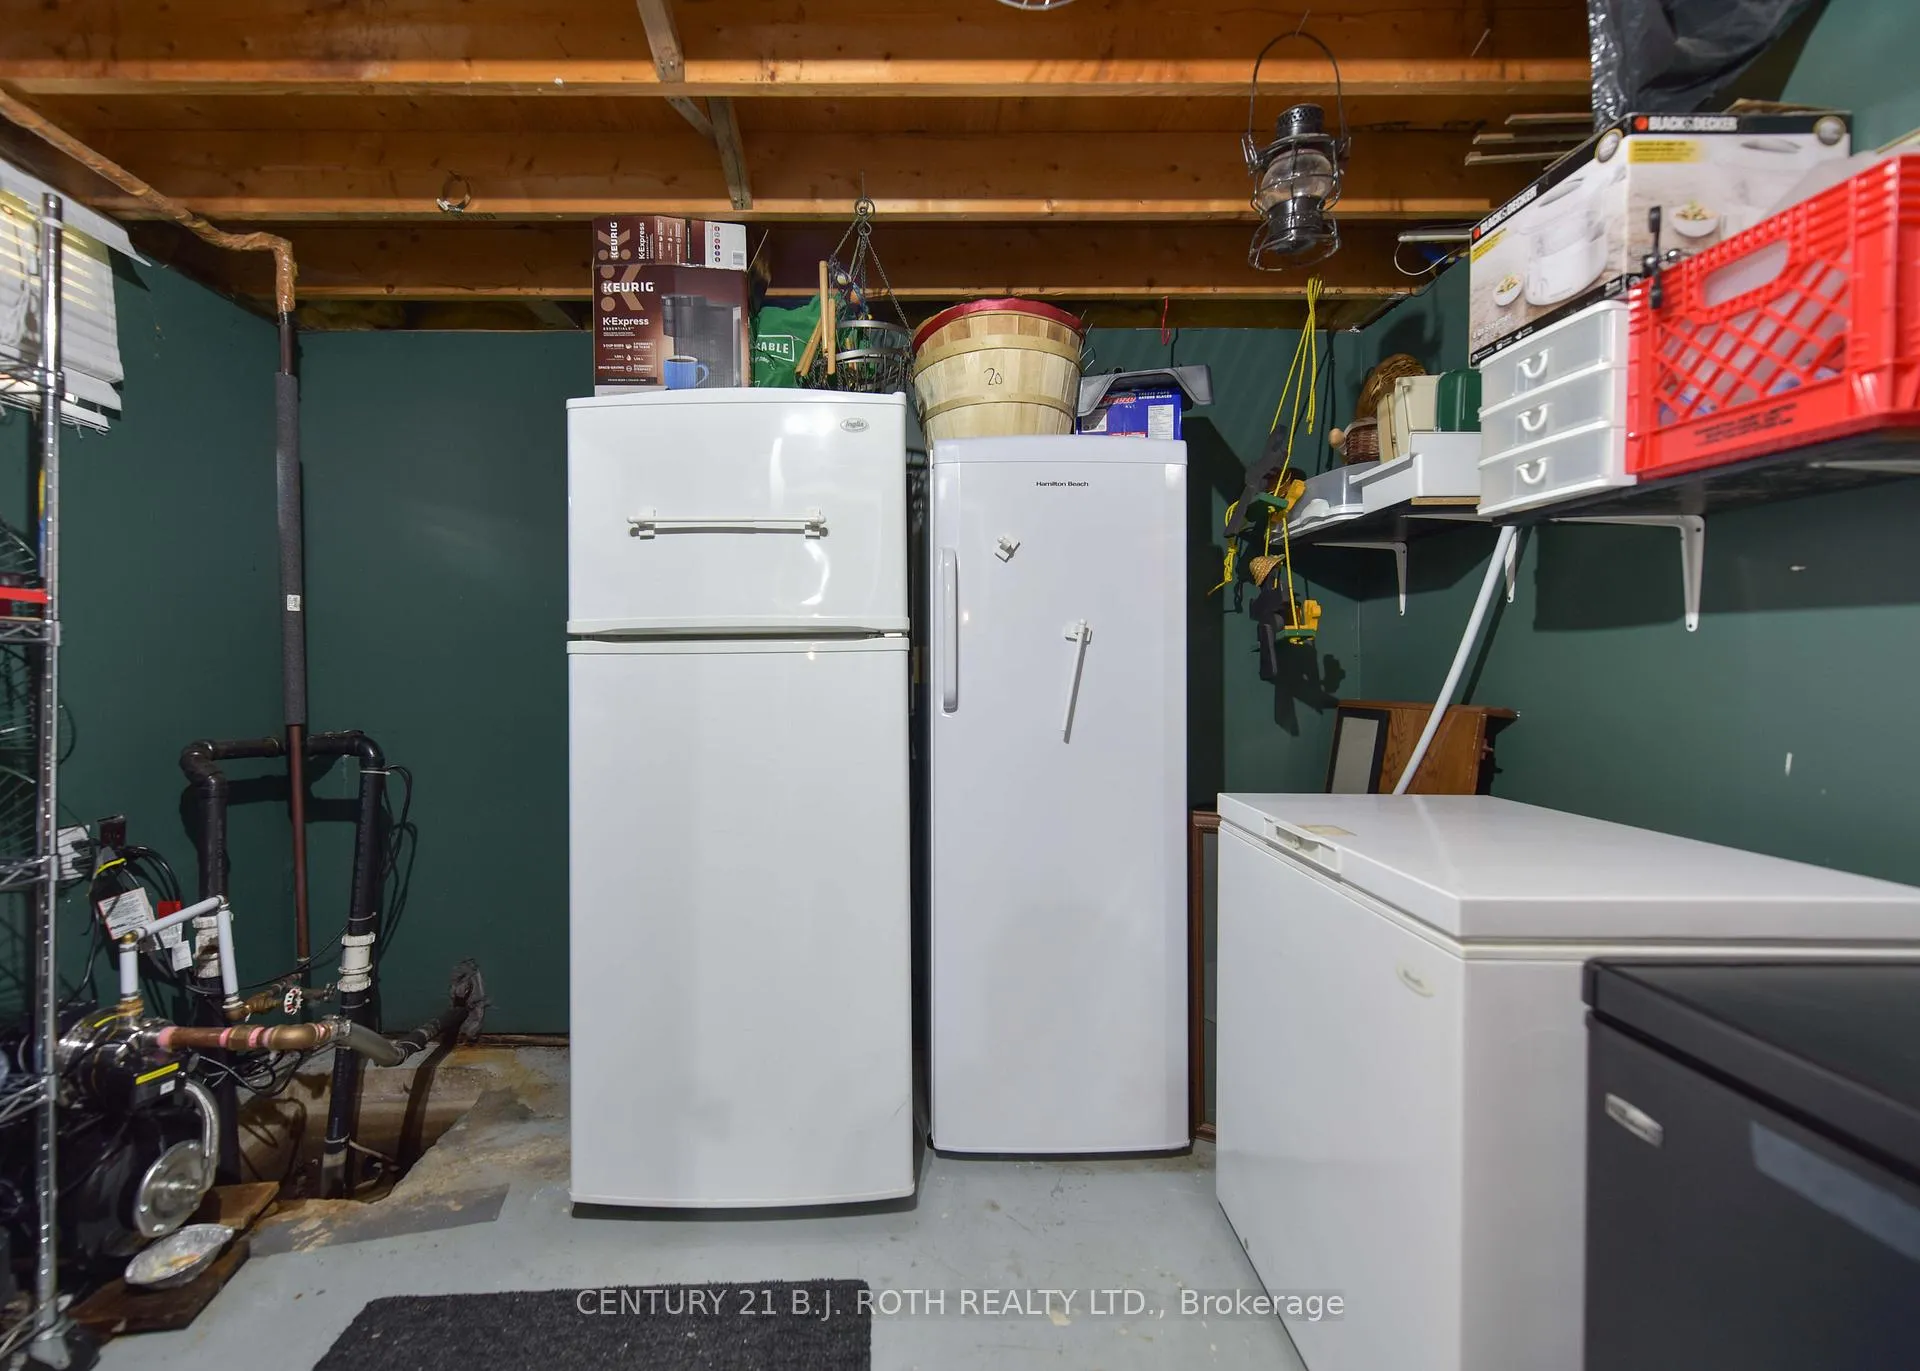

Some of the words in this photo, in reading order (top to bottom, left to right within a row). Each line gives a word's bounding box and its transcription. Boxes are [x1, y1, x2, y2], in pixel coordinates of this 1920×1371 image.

[610, 221, 618, 259] KEURIG
[603, 281, 654, 293] KEURIG
[983, 367, 1003, 386] 20
